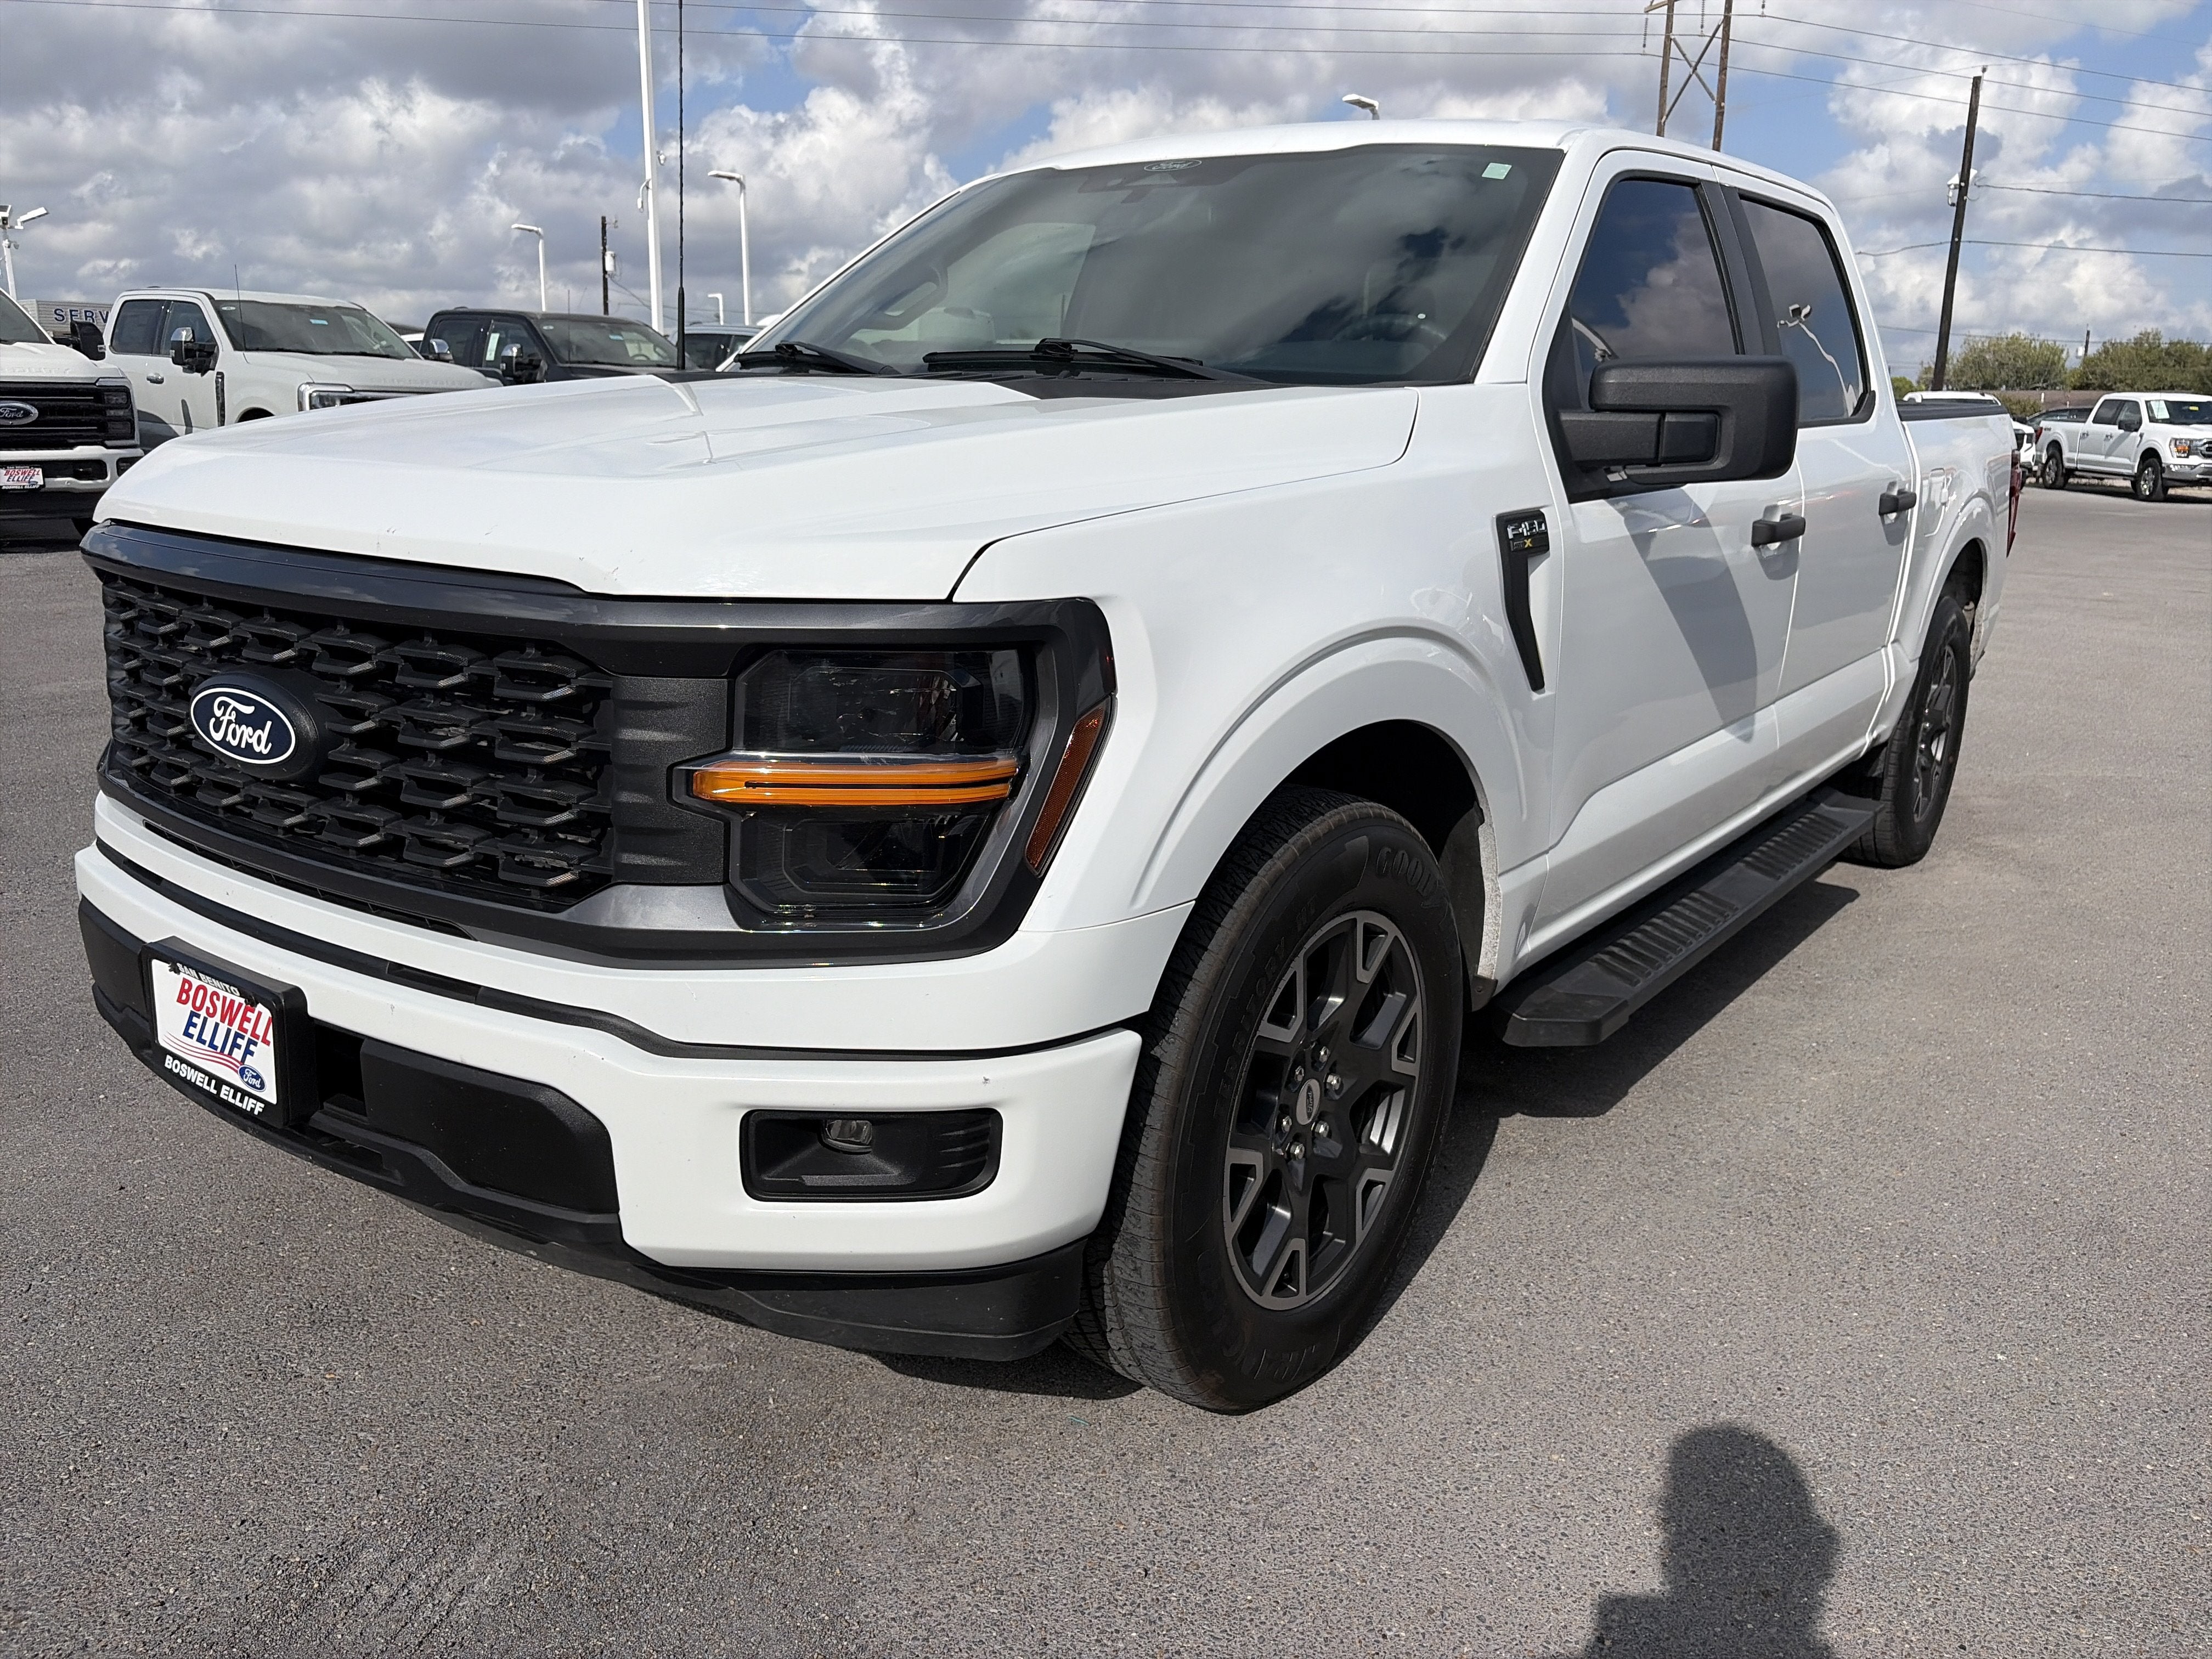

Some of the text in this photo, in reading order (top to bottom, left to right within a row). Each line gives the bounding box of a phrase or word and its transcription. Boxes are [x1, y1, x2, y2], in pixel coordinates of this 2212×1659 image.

[210, 696, 272, 754] Ford
[176, 962, 240, 996] SAN BENITO
[176, 977, 273, 1047] BOSWELL
[182, 1010, 258, 1064] ELLIFF
[165, 1054, 265, 1115] BOSWELL ELLIFF
[243, 1069, 261, 1089] Ford
